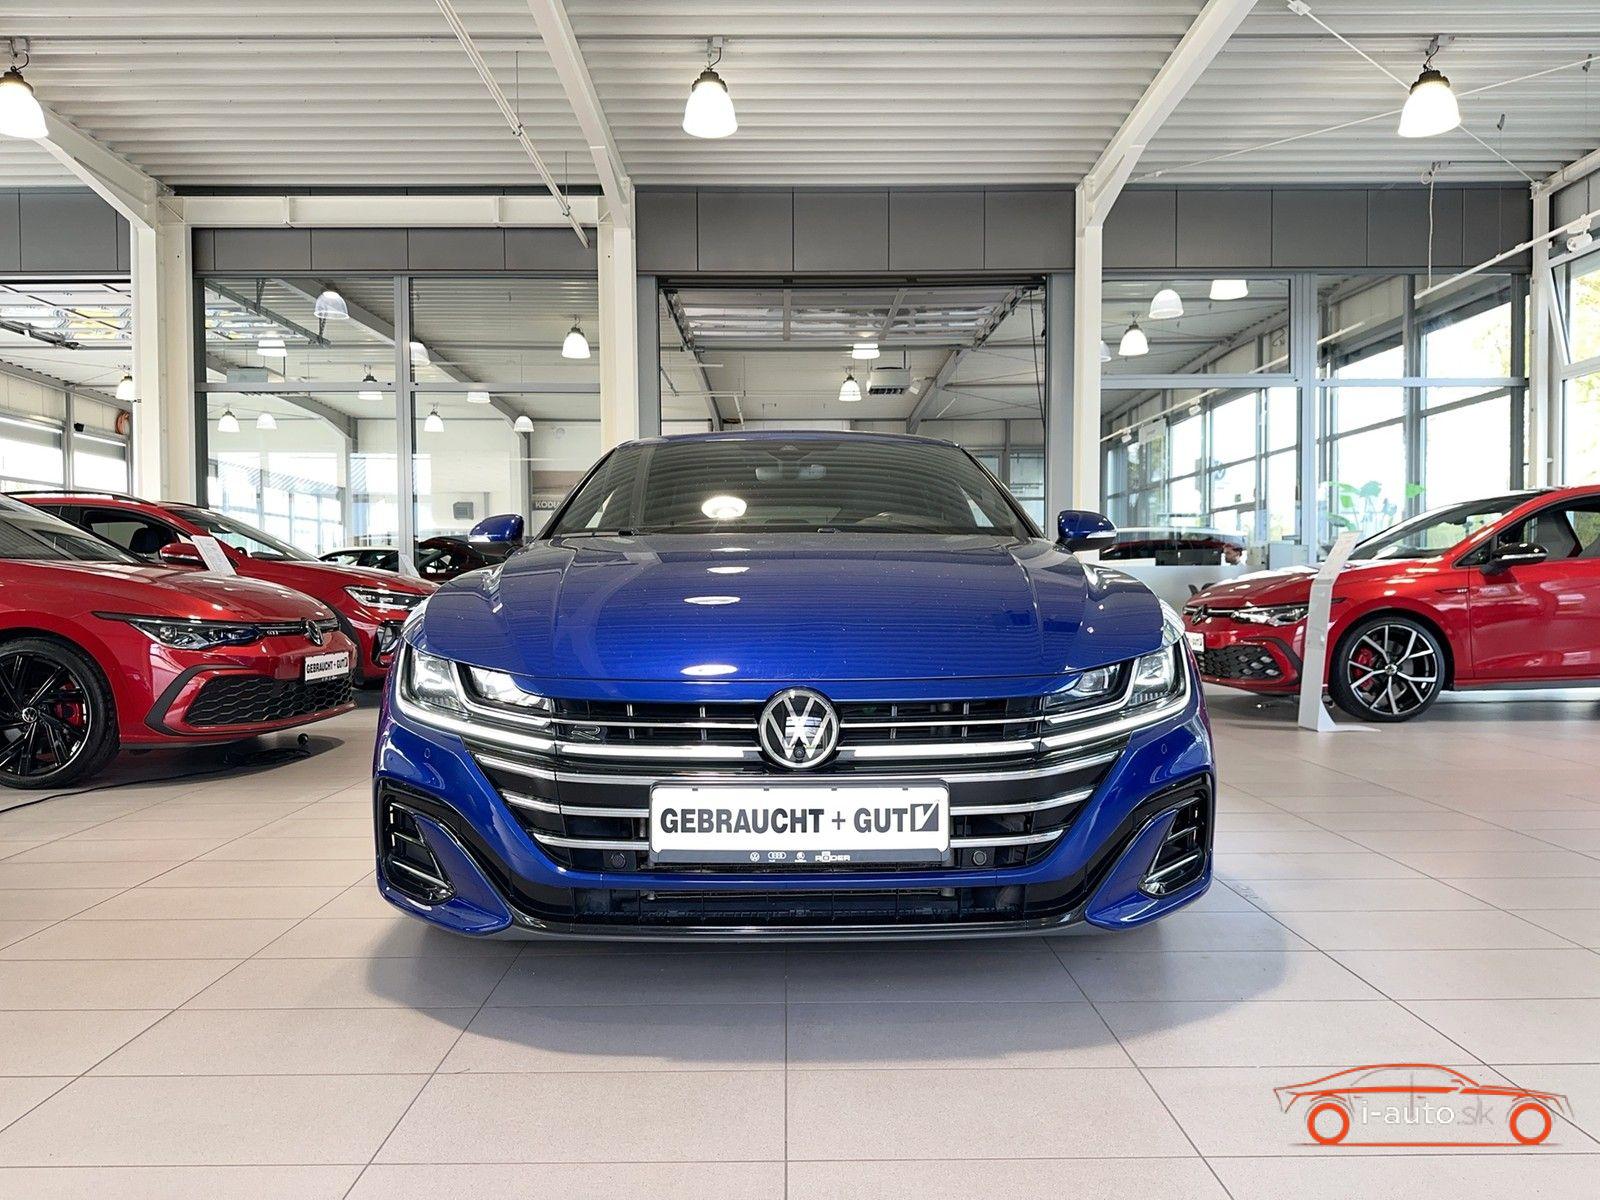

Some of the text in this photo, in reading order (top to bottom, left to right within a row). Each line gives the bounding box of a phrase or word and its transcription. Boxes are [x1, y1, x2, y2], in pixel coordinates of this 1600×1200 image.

[660, 807, 909, 834] GEBRAUCHT + GUT
